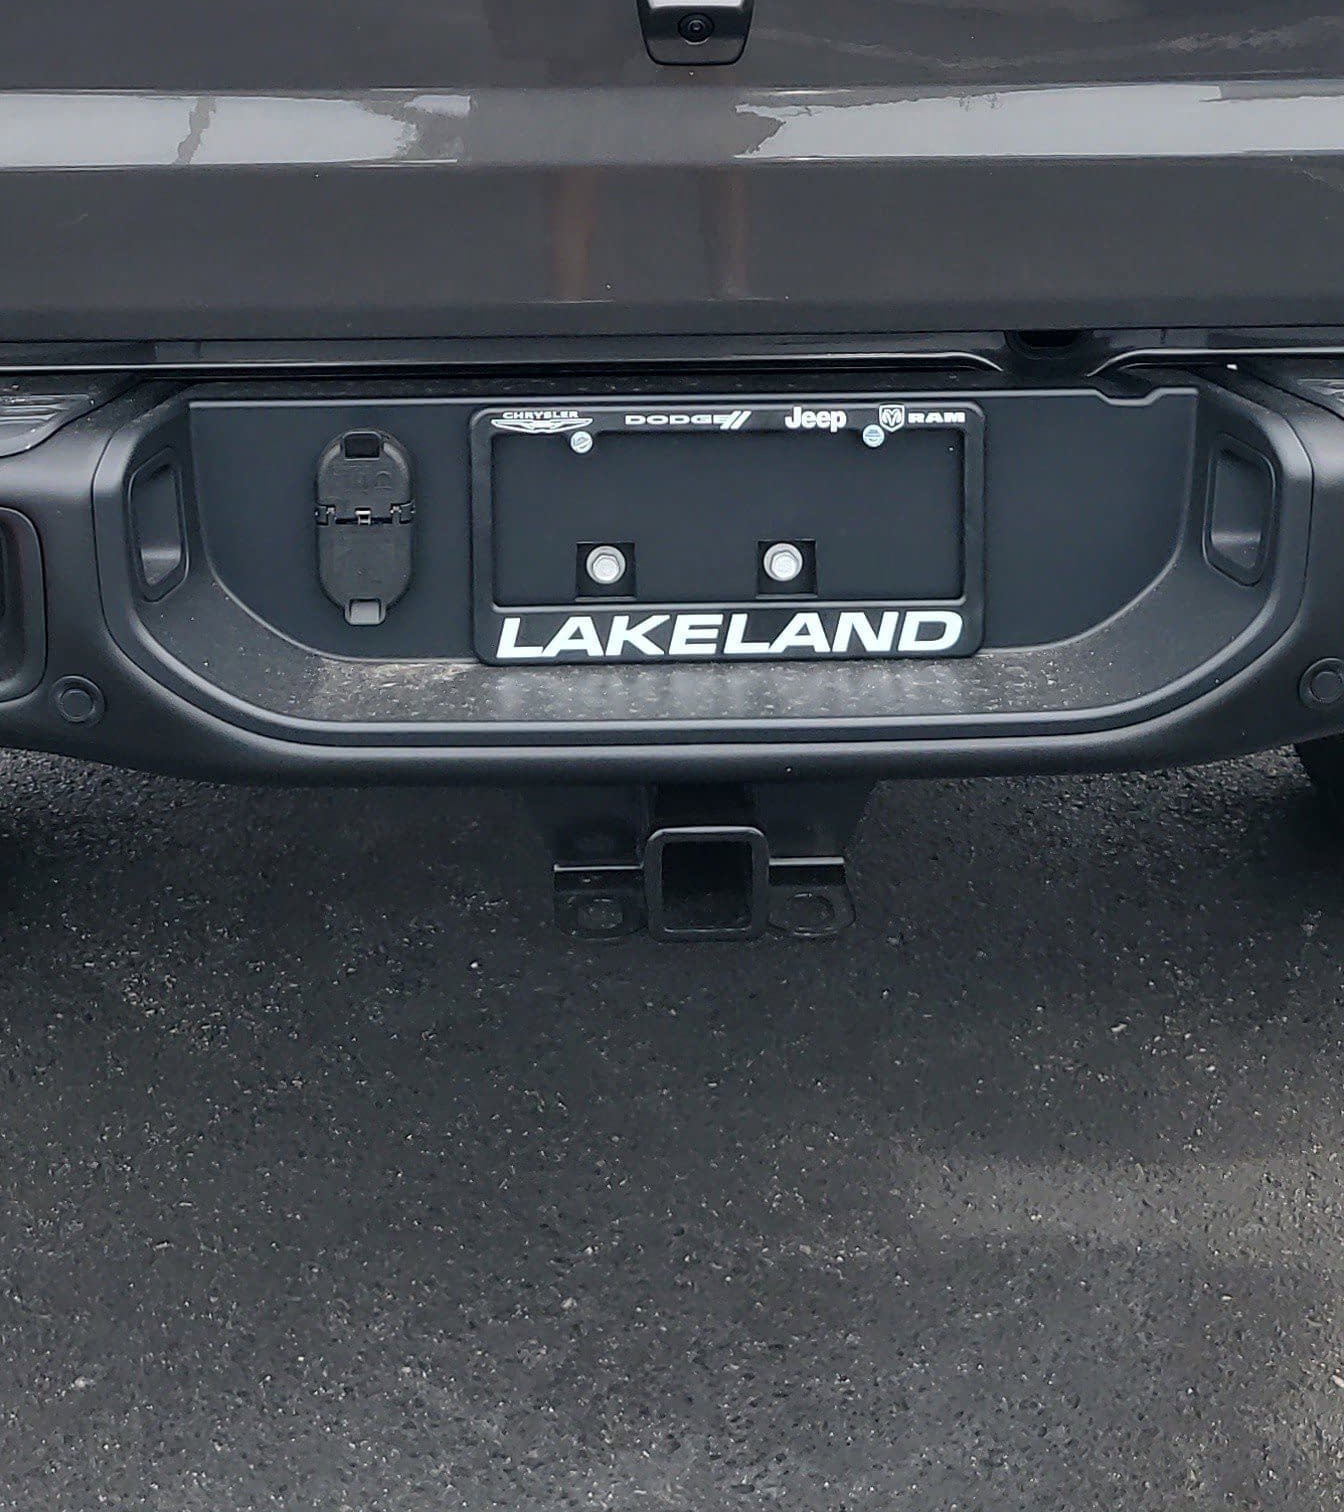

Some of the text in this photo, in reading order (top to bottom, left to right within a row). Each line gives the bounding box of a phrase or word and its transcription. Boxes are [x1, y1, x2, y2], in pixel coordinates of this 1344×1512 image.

[502, 406, 966, 433] CHRYSLER DODGE Jeep RAM
[495, 610, 964, 659] LAKELAND
